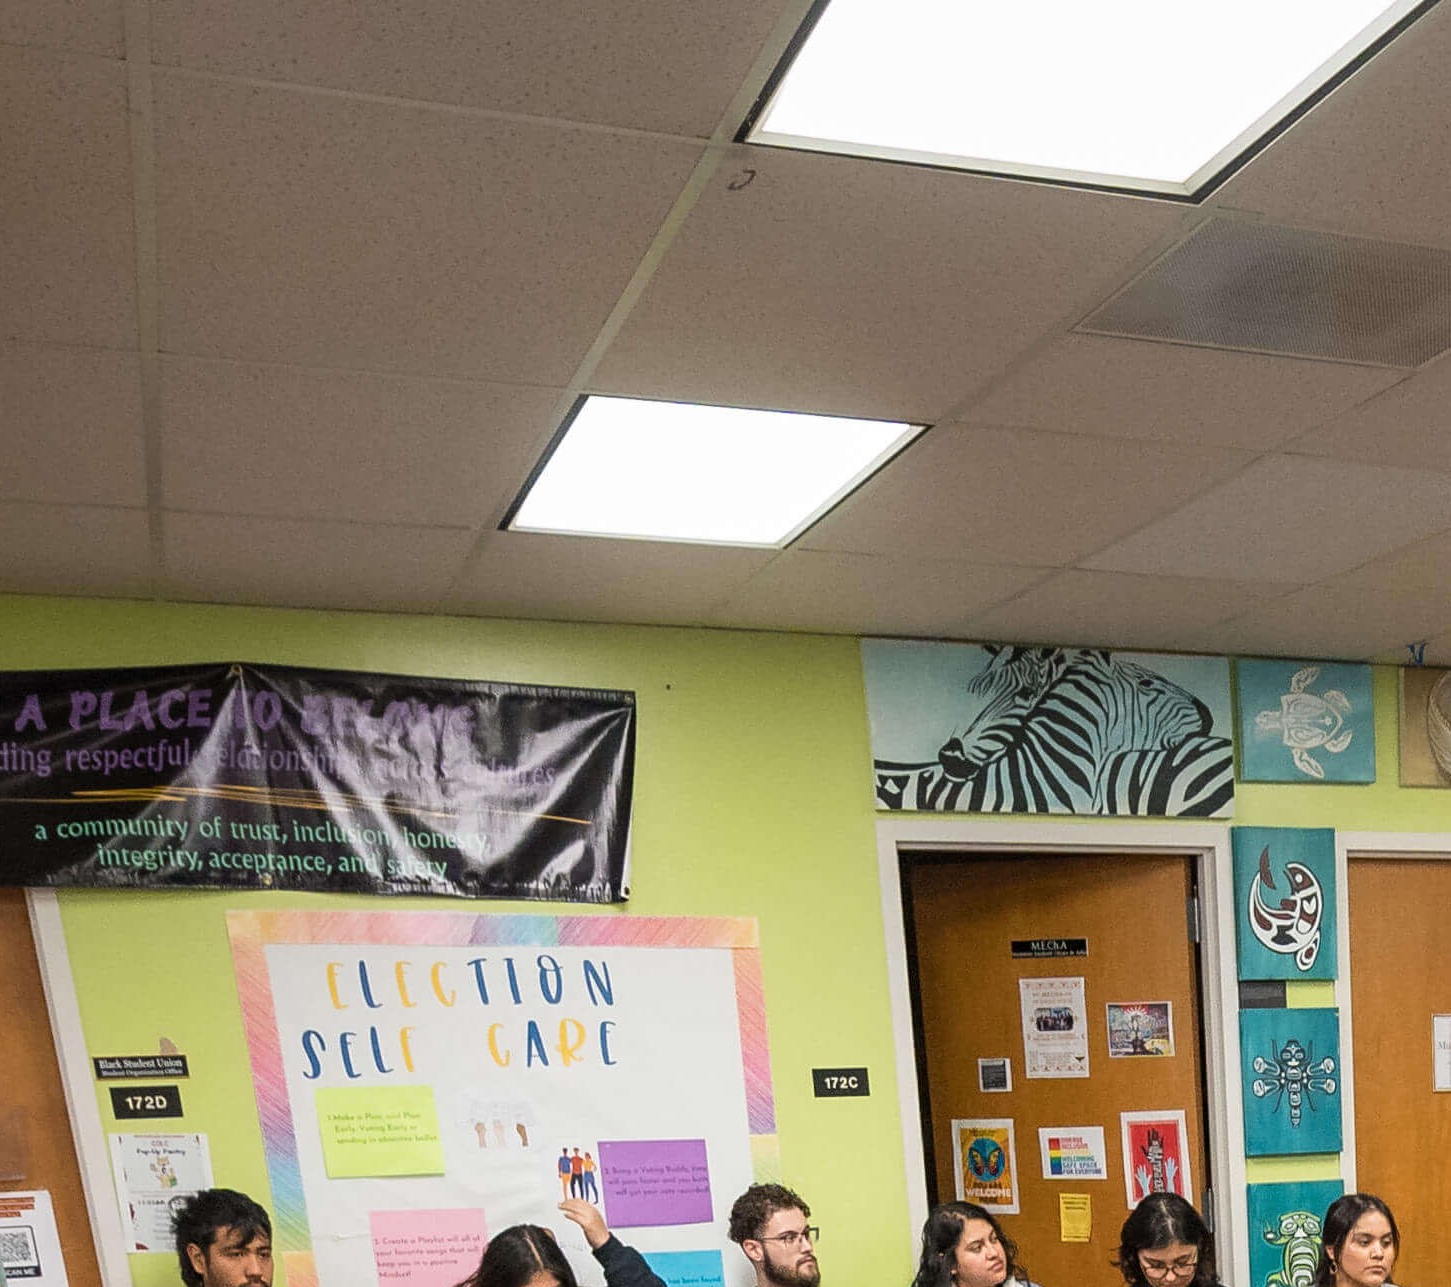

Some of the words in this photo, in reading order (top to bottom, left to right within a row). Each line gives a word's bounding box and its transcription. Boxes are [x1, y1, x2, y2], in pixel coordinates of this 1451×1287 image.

[15, 694, 47, 731] A
[69, 689, 213, 731] PLACE
[66, 738, 190, 775] respectful
[35, 825, 46, 840] a
[57, 819, 189, 843] community
[199, 818, 223, 841] of
[230, 823, 288, 846] trust,
[97, 844, 203, 872] integrity,
[209, 850, 331, 876] acceptance,
[339, 855, 377, 874] and
[326, 954, 614, 1010] ELECTION
[99, 1060, 123, 1069] Black
[123, 1058, 156, 1068] Student
[156, 1057, 183, 1067] Union
[302, 1025, 419, 1079] SELF
[487, 1017, 617, 1067] CARE
[824, 1076, 859, 1089] 172C
[125, 1095, 167, 1110] 172D
[966, 1187, 1012, 1198] WELCOME
